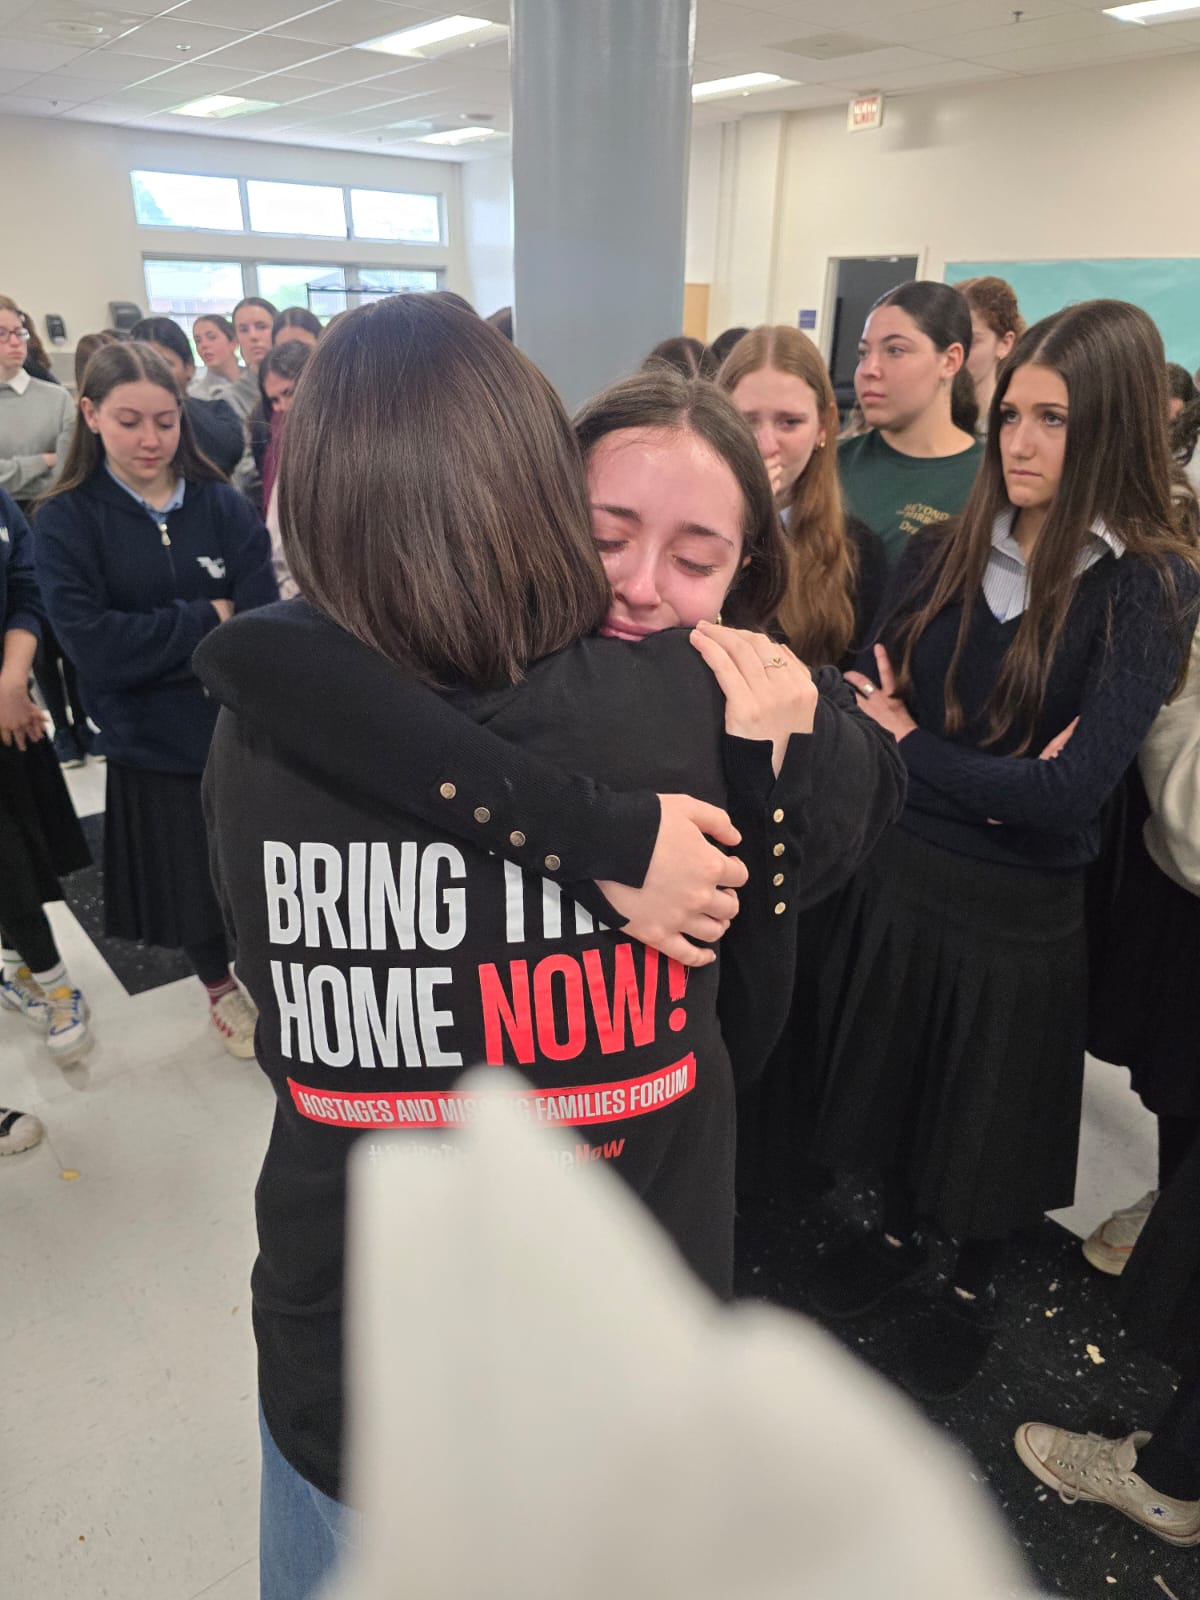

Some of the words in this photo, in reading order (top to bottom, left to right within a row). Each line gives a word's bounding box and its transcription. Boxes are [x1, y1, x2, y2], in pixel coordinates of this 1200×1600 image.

[263, 841, 467, 950] BRING
[270, 960, 463, 1068] HOME
[478, 943, 688, 1066] NOW!
[298, 1091, 394, 1123] HOSTAGES
[396, 1099, 437, 1122] AND
[439, 1097, 531, 1123] MISG
[535, 1088, 625, 1121] FAMILIES
[630, 1065, 688, 1111] FORUM
